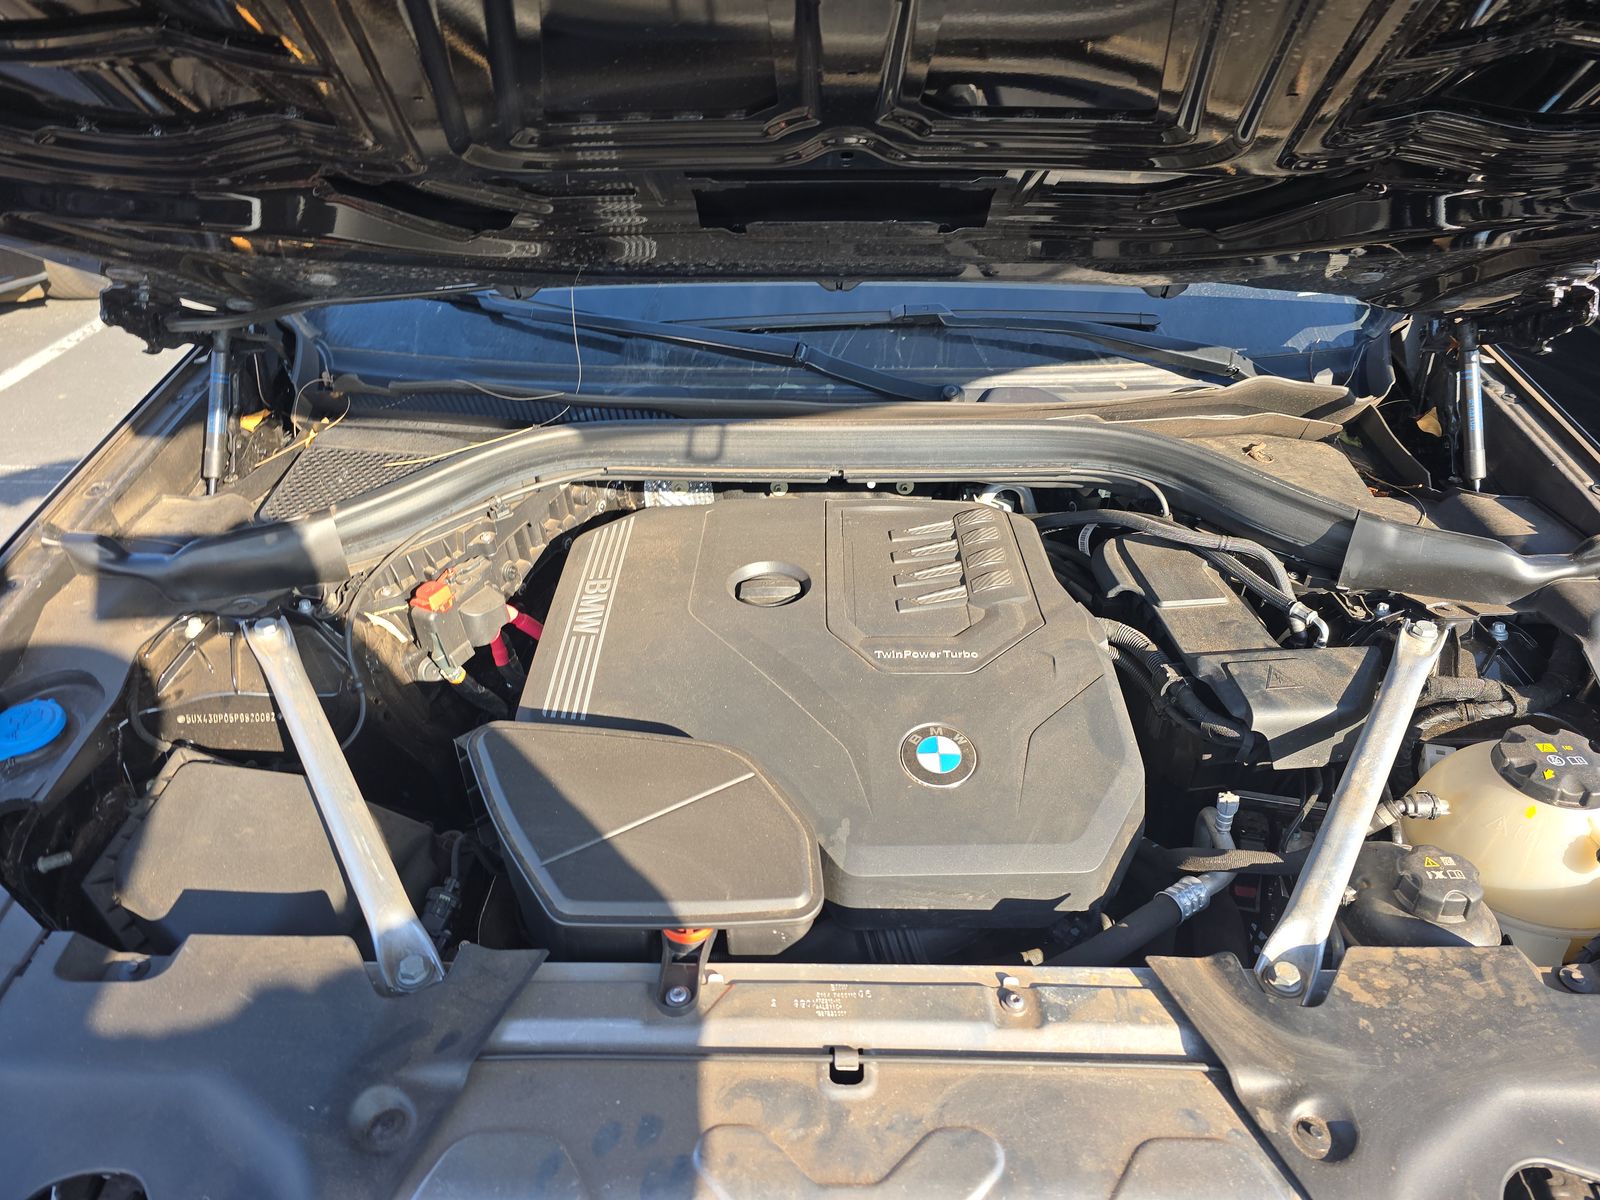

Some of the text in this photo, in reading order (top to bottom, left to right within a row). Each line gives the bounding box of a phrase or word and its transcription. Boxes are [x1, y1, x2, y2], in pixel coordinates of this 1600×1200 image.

[572, 579, 612, 633] BMW
[874, 650, 979, 659] TwinPower Turbo
[908, 727, 968, 745] BMW
